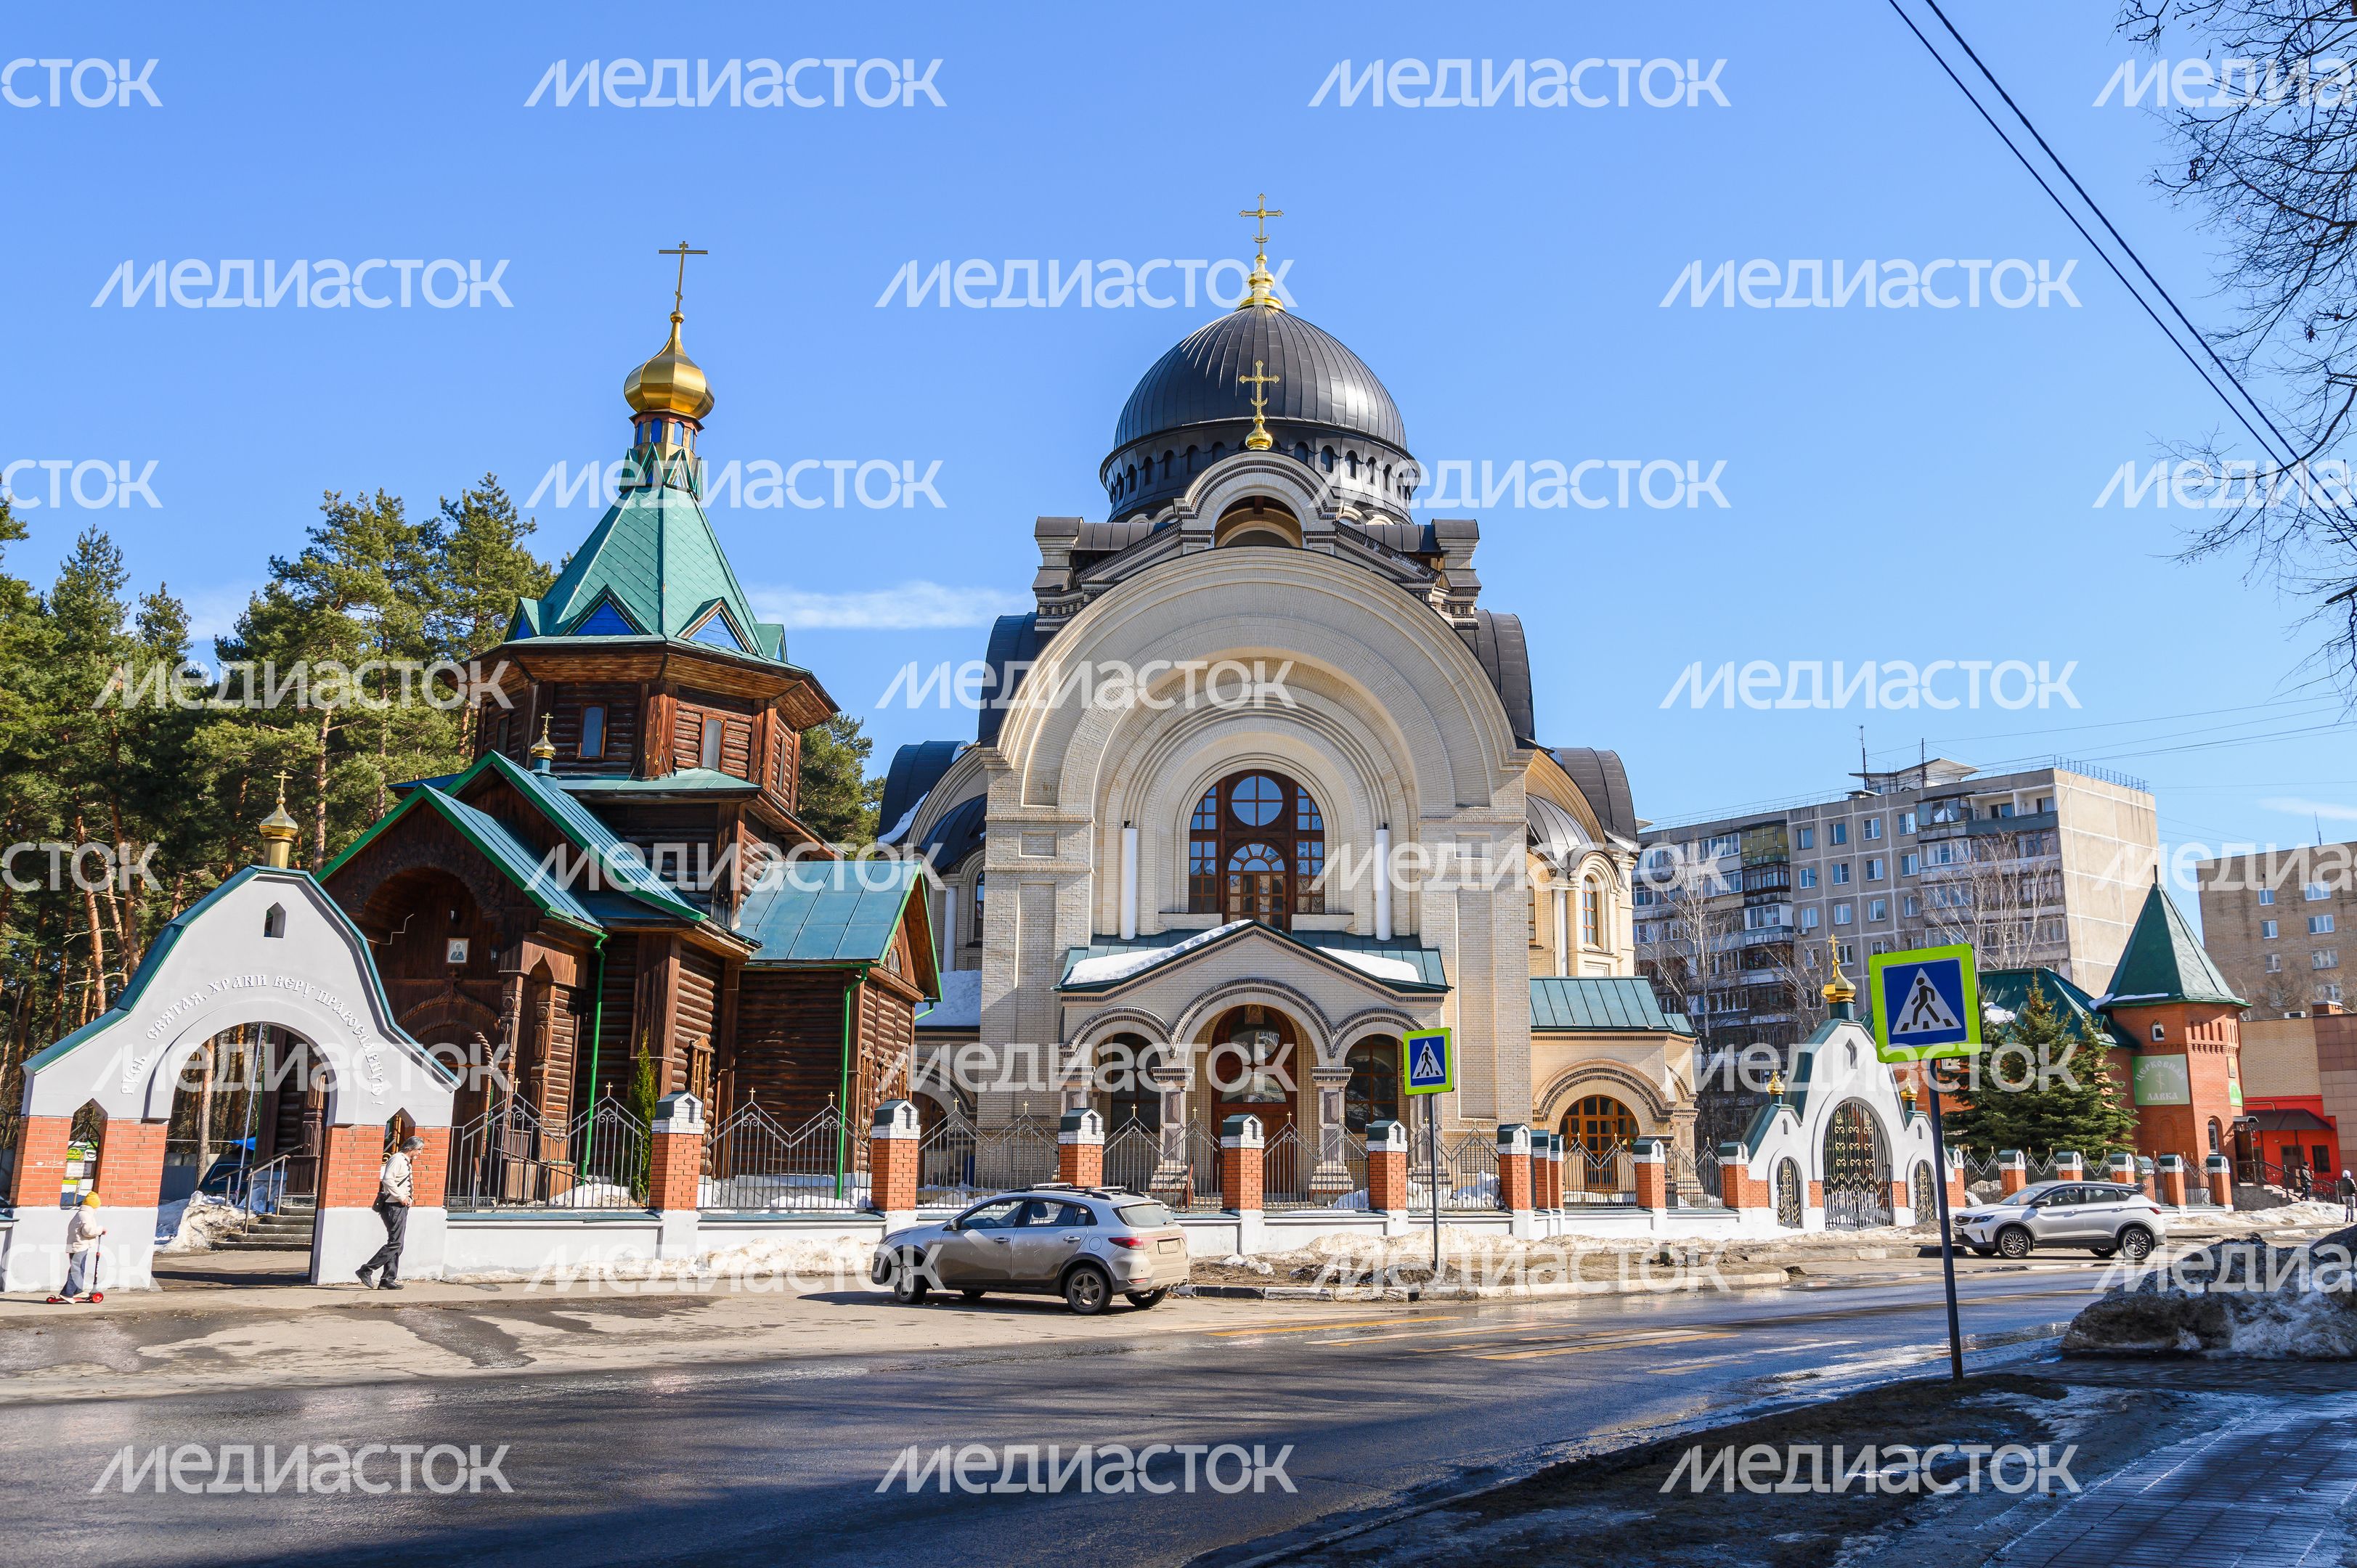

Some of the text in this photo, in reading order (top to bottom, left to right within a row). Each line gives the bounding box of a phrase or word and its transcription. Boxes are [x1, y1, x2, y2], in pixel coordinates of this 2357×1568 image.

[208, 974, 267, 995] ХРАНИ
[272, 976, 315, 998] ВЕРУ
[2135, 1060, 2186, 1082] ЦЕРКОВНАЯ
[2147, 1092, 2178, 1101] ЛАВКА
